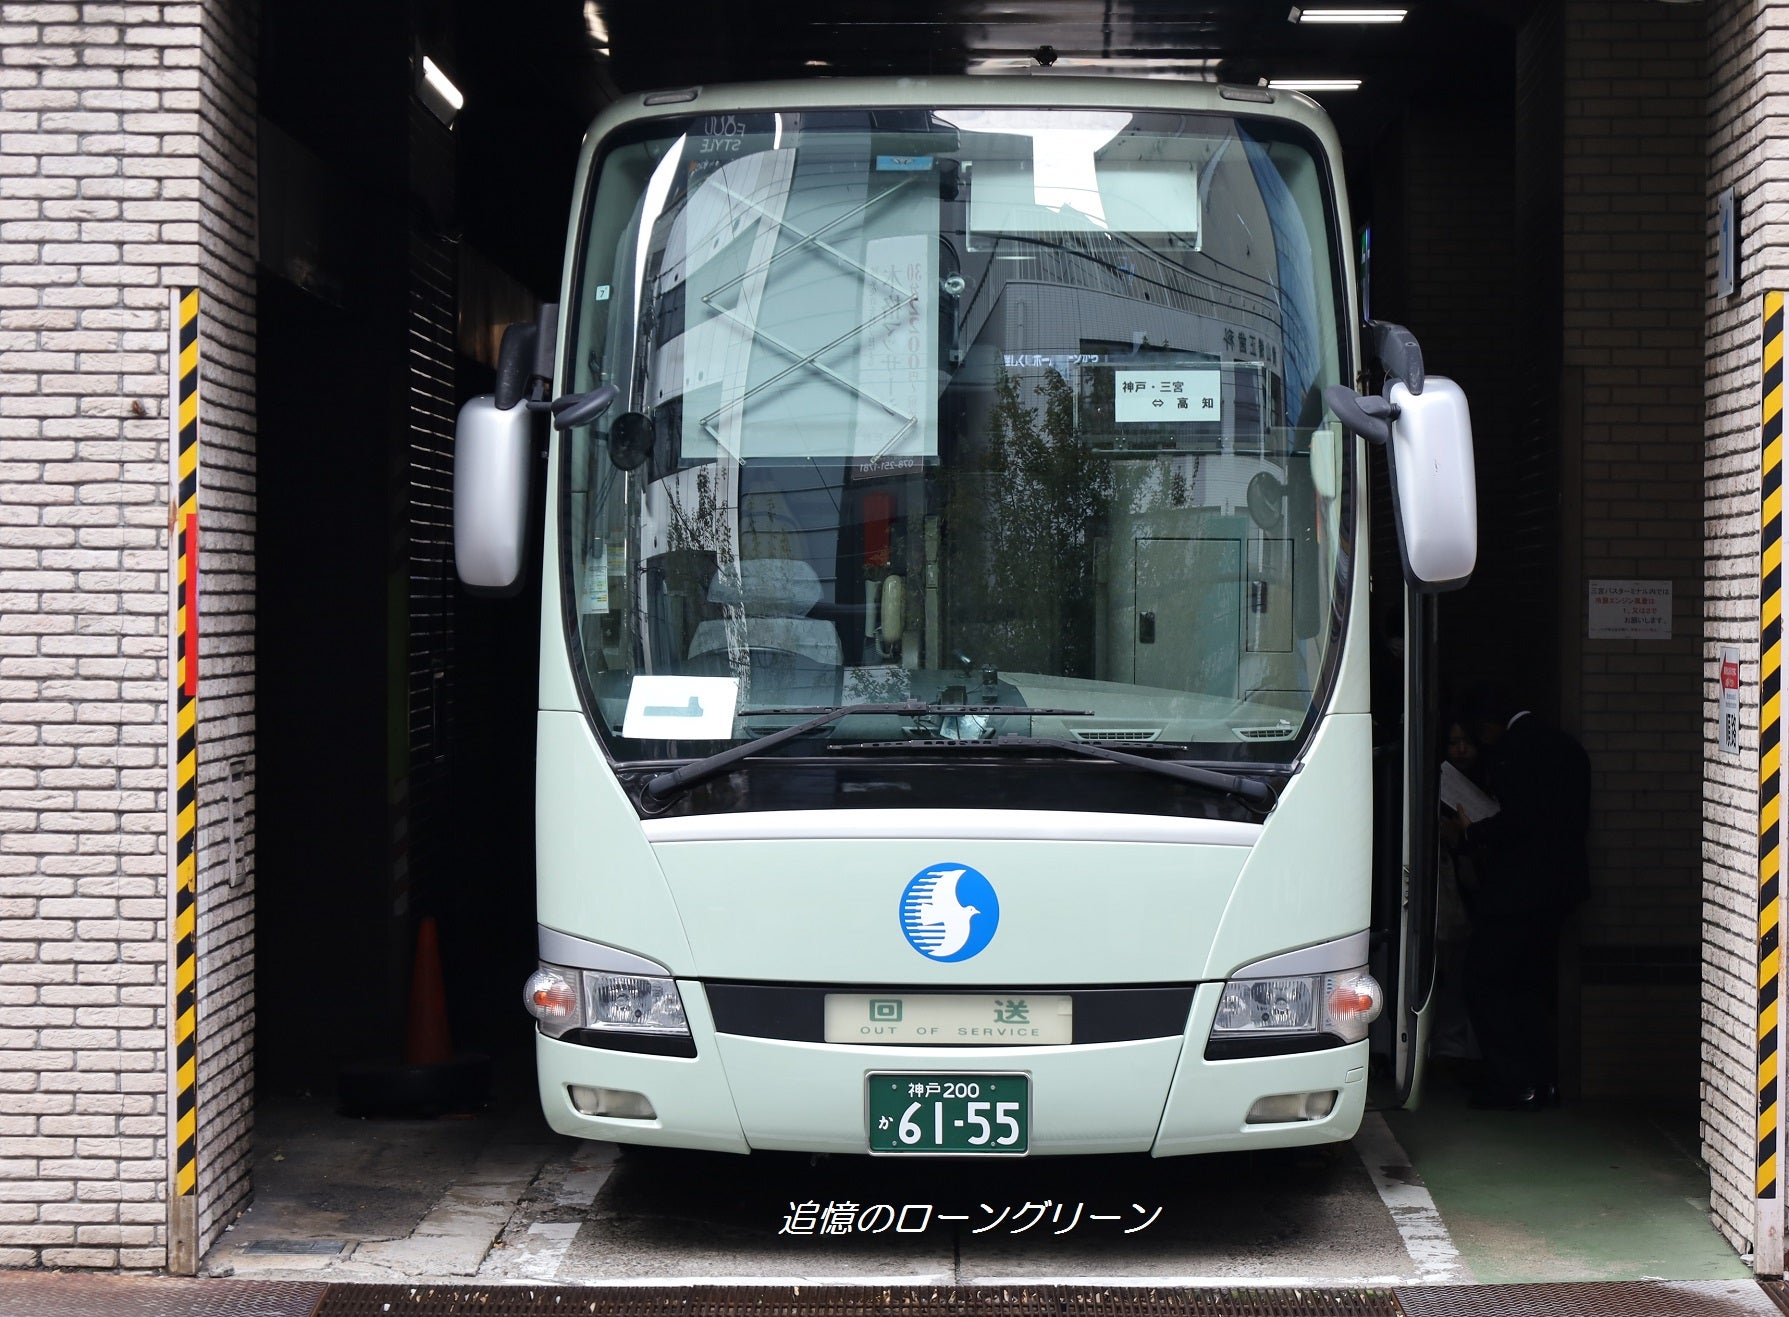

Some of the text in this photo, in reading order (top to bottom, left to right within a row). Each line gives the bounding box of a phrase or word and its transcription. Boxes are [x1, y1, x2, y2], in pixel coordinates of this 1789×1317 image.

[1122, 381, 1184, 394] 神戸・三宮
[1177, 397, 1214, 409] 高知
[860, 1026, 1041, 1037] OUT OF SERVICE
[878, 1101, 1020, 1145] か 61-55
